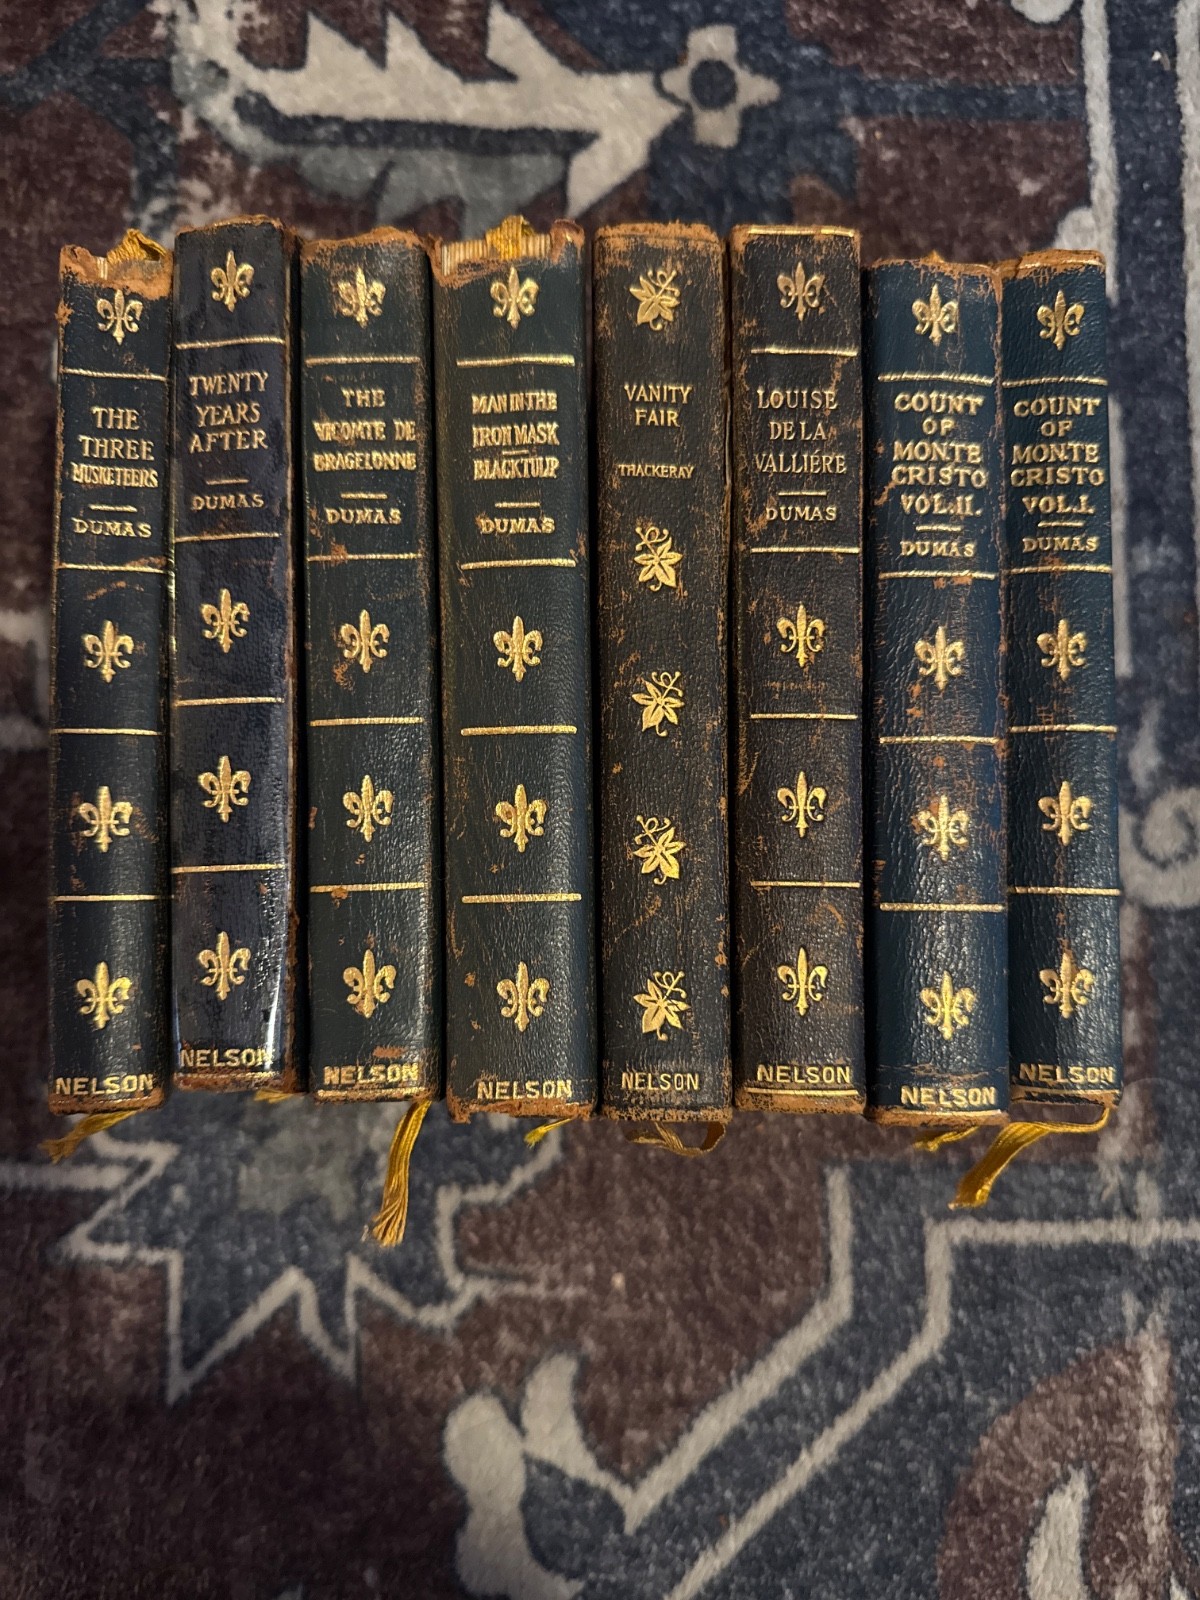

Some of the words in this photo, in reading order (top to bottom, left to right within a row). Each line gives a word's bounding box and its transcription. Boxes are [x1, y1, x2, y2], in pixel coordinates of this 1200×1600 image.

[189, 371, 269, 396] TWENTY
[624, 384, 692, 404] VANITY
[341, 387, 386, 408] THE
[472, 392, 508, 415] MAN
[509, 391, 525, 412] IN
[525, 389, 558, 411] THE
[757, 388, 838, 410] LOUISE
[894, 391, 985, 416] COUNT
[1013, 396, 1102, 417] COUNT
[91, 405, 140, 430] THE
[196, 402, 261, 427] YEARS
[635, 409, 680, 427] FAIR
[393, 419, 416, 441] DE
[472, 425, 512, 448] IRON
[514, 421, 560, 446] MASK
[769, 422, 796, 441] DE
[800, 422, 829, 441] LA
[922, 417, 956, 436] OF
[1040, 420, 1073, 437] OF
[78, 434, 155, 461] THREE
[189, 430, 269, 453] AFTER
[892, 440, 983, 464] MONTE
[313, 451, 417, 471] BRAGELONNE
[1011, 442, 1100, 465] MONTE
[70, 461, 158, 488] MUSKETEERS
[473, 458, 522, 480] BLACK
[521, 456, 560, 479] TULIP
[618, 463, 694, 479] THACKERAY
[891, 465, 989, 489] CRISTO
[1010, 466, 1106, 487] CRISTO
[190, 493, 265, 511] DUMAS
[325, 508, 402, 524] DUMAS
[766, 506, 837, 522] DUMAS
[71, 517, 152, 538] DUMAS
[480, 518, 556, 534] DUMAS
[900, 540, 977, 558] DUMAS
[1022, 536, 1100, 553] DUMAS
[179, 1047, 275, 1068] NELSON
[323, 1062, 420, 1086] NELSON
[621, 1072, 701, 1091] NELSON
[757, 1065, 851, 1084] NELSON
[1019, 1062, 1116, 1085] NELSON
[55, 1073, 154, 1096] NELSON
[476, 1080, 573, 1100] NELSON
[901, 1086, 997, 1108] NELSON
